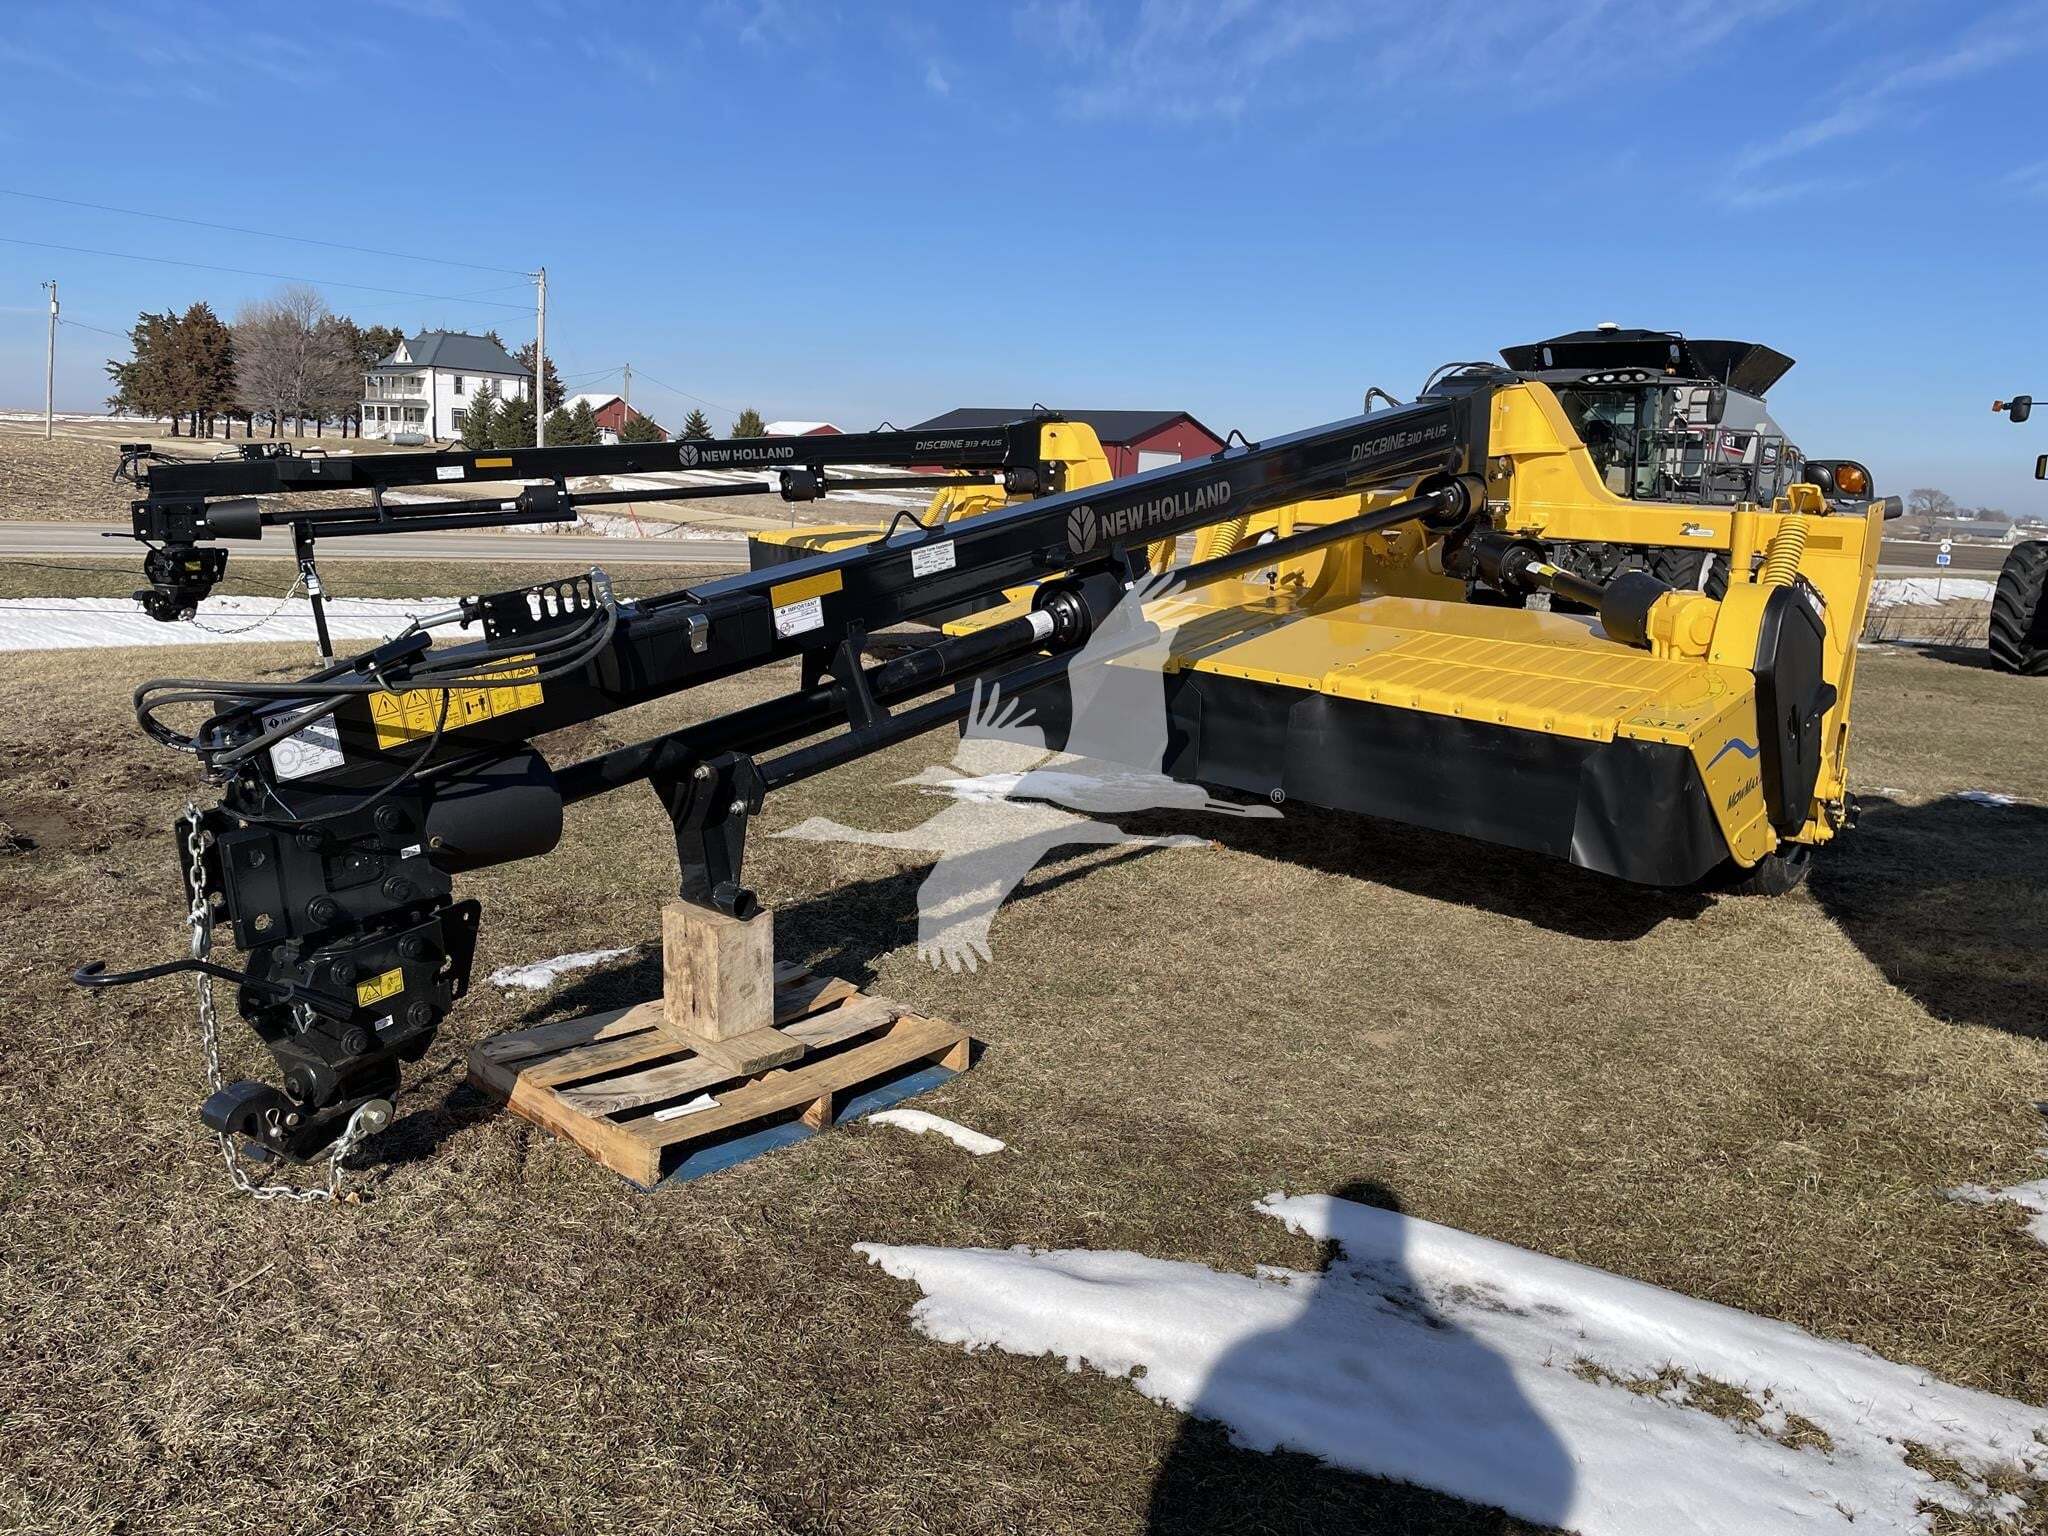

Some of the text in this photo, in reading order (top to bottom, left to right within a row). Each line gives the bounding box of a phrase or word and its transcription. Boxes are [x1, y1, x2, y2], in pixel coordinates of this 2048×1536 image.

[915, 439, 1003, 451] DISCBINE 313 PLUS
[1351, 424, 1448, 461] DISCBINE 310 PLUS
[701, 446, 794, 462] NEW HOLLAND
[1101, 481, 1231, 539] NEW HOLLAND
[787, 600, 817, 613] IMPORTANT
